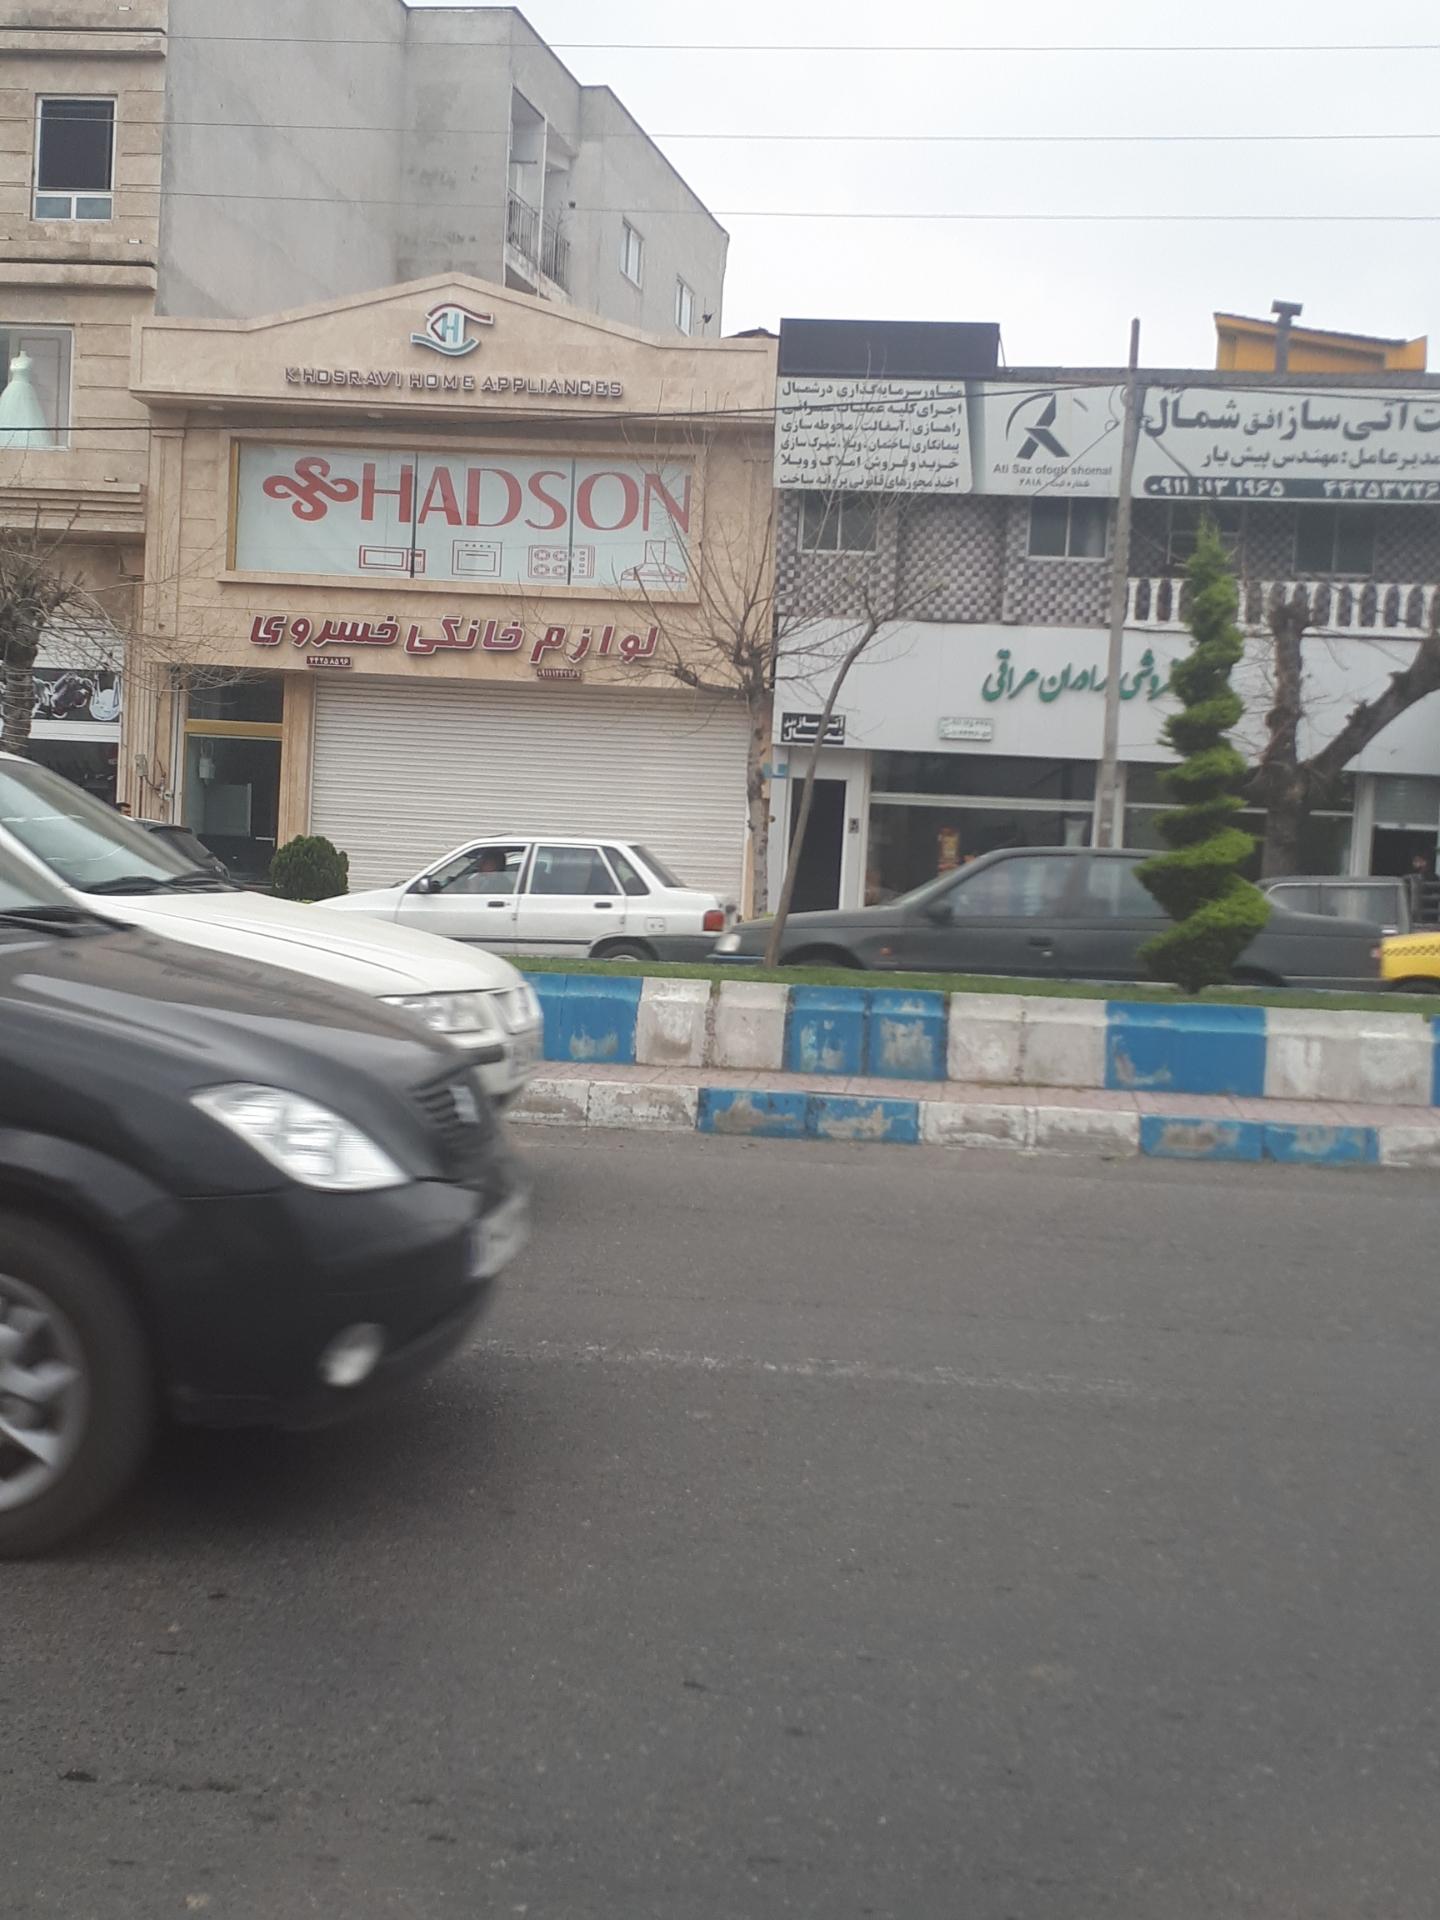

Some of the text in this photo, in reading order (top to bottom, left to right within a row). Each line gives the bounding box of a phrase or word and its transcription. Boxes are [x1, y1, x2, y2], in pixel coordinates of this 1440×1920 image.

[284, 367, 623, 398] KHOSRAVI HOME APPLIANCES
[917, 403, 962, 418] اجرای
[1144, 397, 1240, 438] شمال
[1243, 408, 1283, 436] افق
[993, 463, 1009, 474] Ati
[1012, 463, 1032, 475] Saz
[1272, 448, 1339, 469] مهندس
[360, 463, 691, 534] HADSON
[250, 615, 659, 664] لوازم خانگی خسروی
